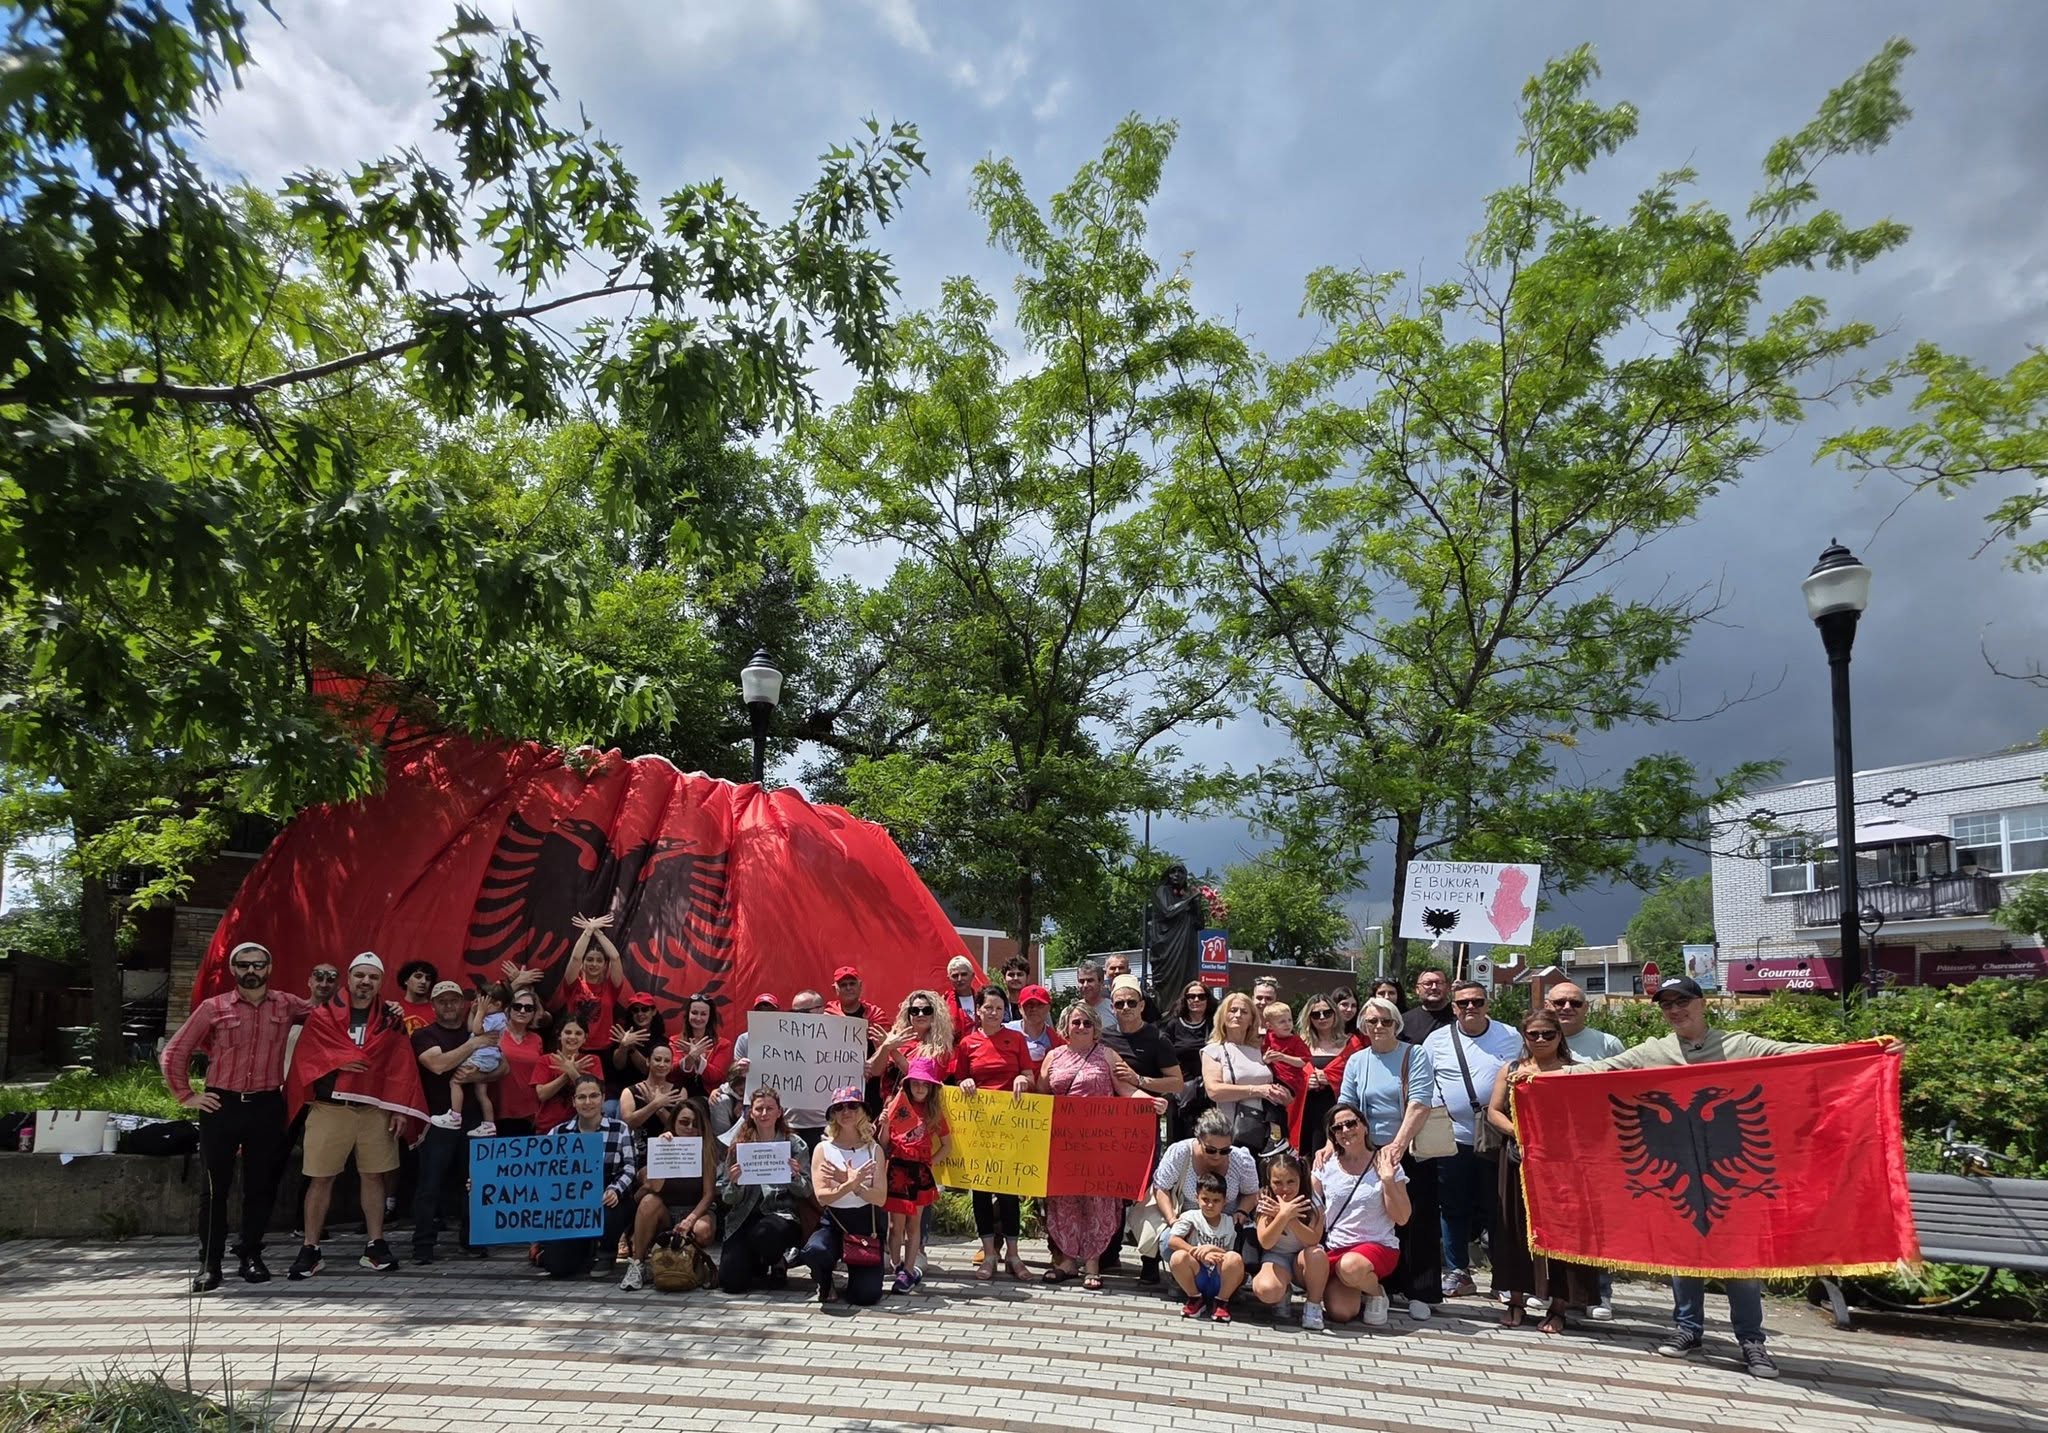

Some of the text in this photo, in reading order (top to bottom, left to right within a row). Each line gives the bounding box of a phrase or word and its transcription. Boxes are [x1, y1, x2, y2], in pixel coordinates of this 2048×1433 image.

[1414, 876, 1480, 888] E BUKURA
[1757, 967, 1812, 978] Gourmet
[1786, 979, 1814, 989] Aldo
[779, 1019, 863, 1045] RAMA IK
[762, 1045, 806, 1063] RAMA
[761, 1073, 803, 1092] RAMA
[950, 1108, 986, 1122] SHTË
[1008, 1098, 1041, 1114] NUK
[970, 1158, 980, 1170] IS
[985, 1160, 1004, 1174] NOT
[1013, 1162, 1041, 1178] FOR
[481, 1180, 594, 1206] RAMA JEP
[495, 1207, 603, 1230] DOREHEQJEN
